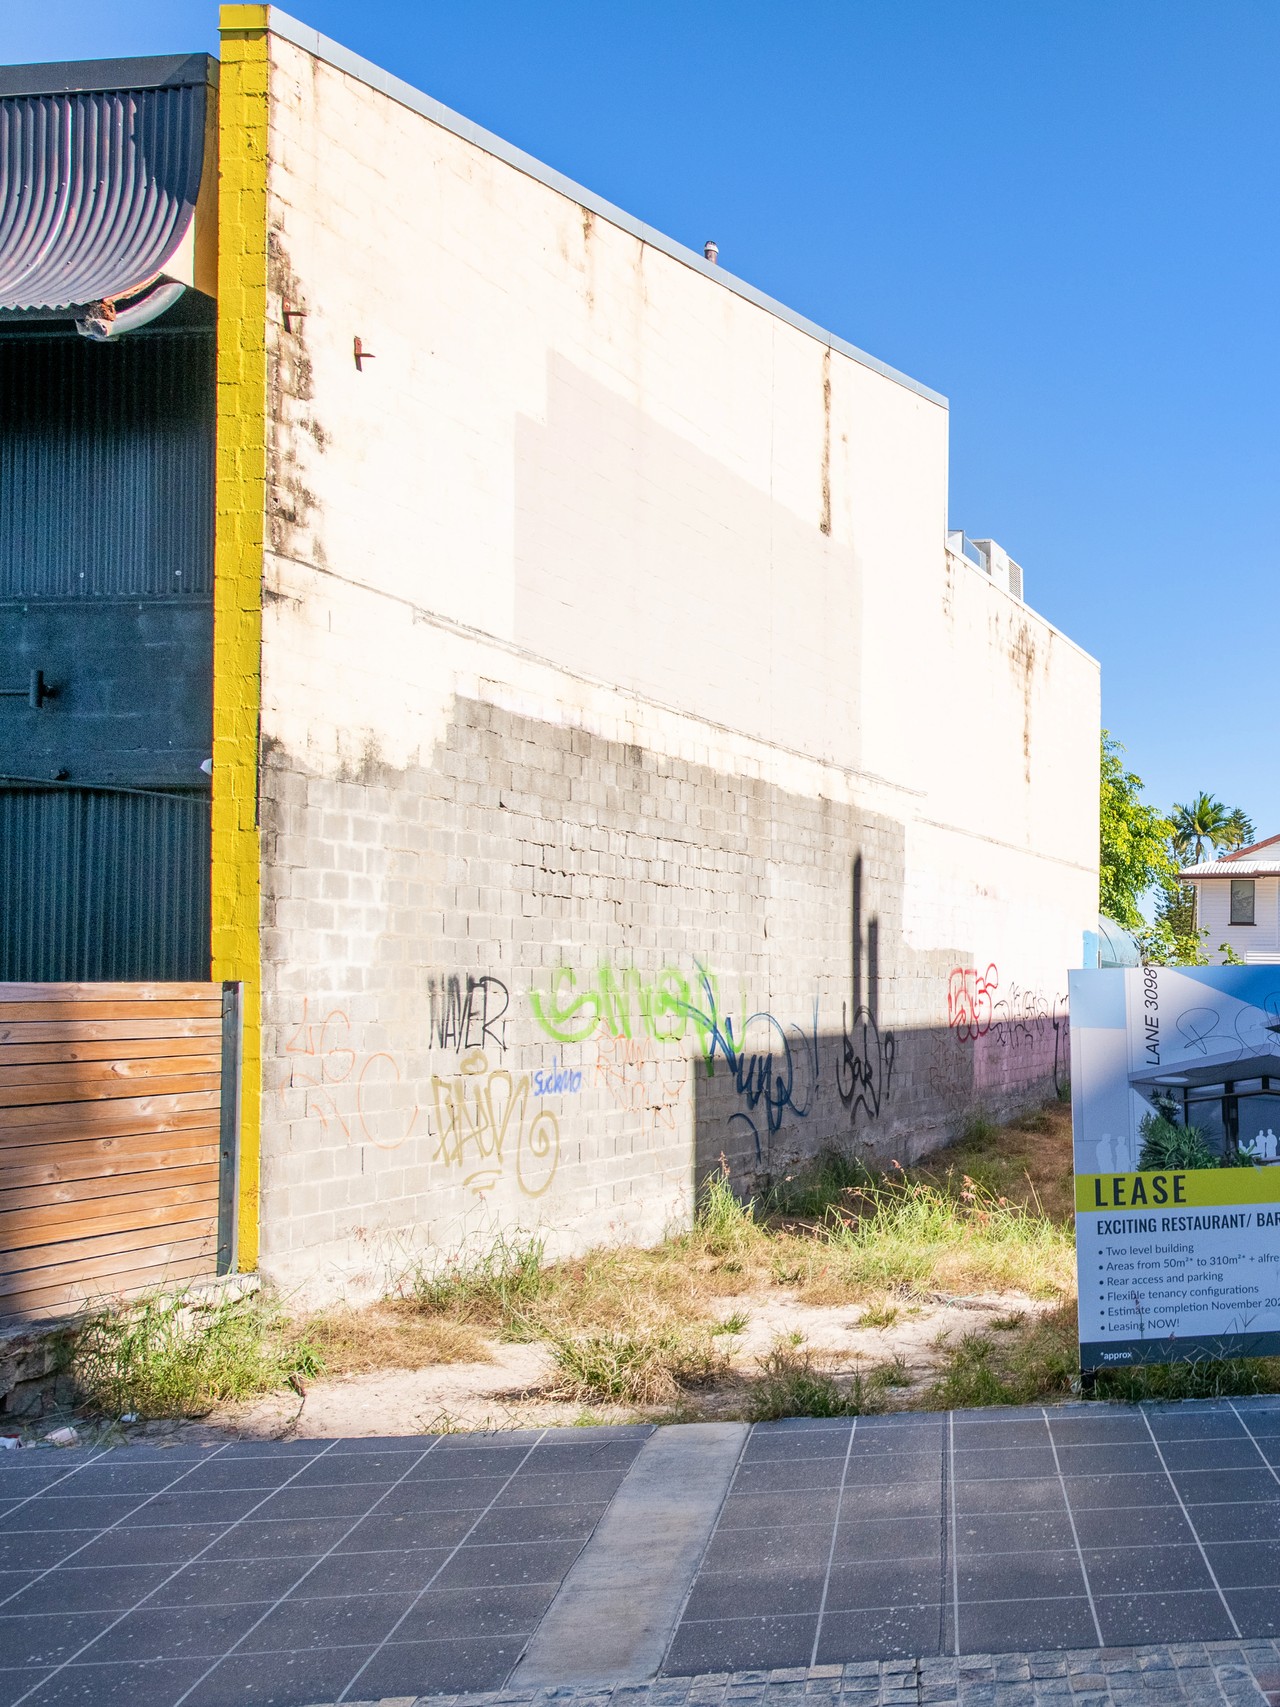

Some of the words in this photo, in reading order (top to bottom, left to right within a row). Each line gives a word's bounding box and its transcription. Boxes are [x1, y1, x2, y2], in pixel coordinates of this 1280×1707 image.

[1143, 967, 1159, 1011] 3098
[1145, 1015, 1161, 1065] LANE
[1094, 1175, 1187, 1207] LEASE
[1097, 1218, 1157, 1235] EXCITING
[1161, 1213, 1252, 1232] RESTAURANT/
[1106, 1246, 1127, 1256] Two
[1129, 1244, 1152, 1255] level
[1155, 1243, 1195, 1254] building
[1106, 1262, 1135, 1271] Areas
[1137, 1260, 1160, 1269] from
[1196, 1258, 1207, 1267] to
[1107, 1277, 1129, 1286] Rear
[1131, 1276, 1164, 1285] access
[1166, 1273, 1185, 1283] and
[1187, 1272, 1224, 1283] parking
[1107, 1290, 1146, 1301] Flexible
[1148, 1289, 1187, 1299] tenancy
[1190, 1284, 1259, 1297] configurations
[1108, 1306, 1151, 1317] Estimate
[1153, 1301, 1209, 1314] completion
[1211, 1299, 1262, 1310] November
[1108, 1321, 1145, 1332] Leasing
[1148, 1318, 1180, 1329] NOW!
